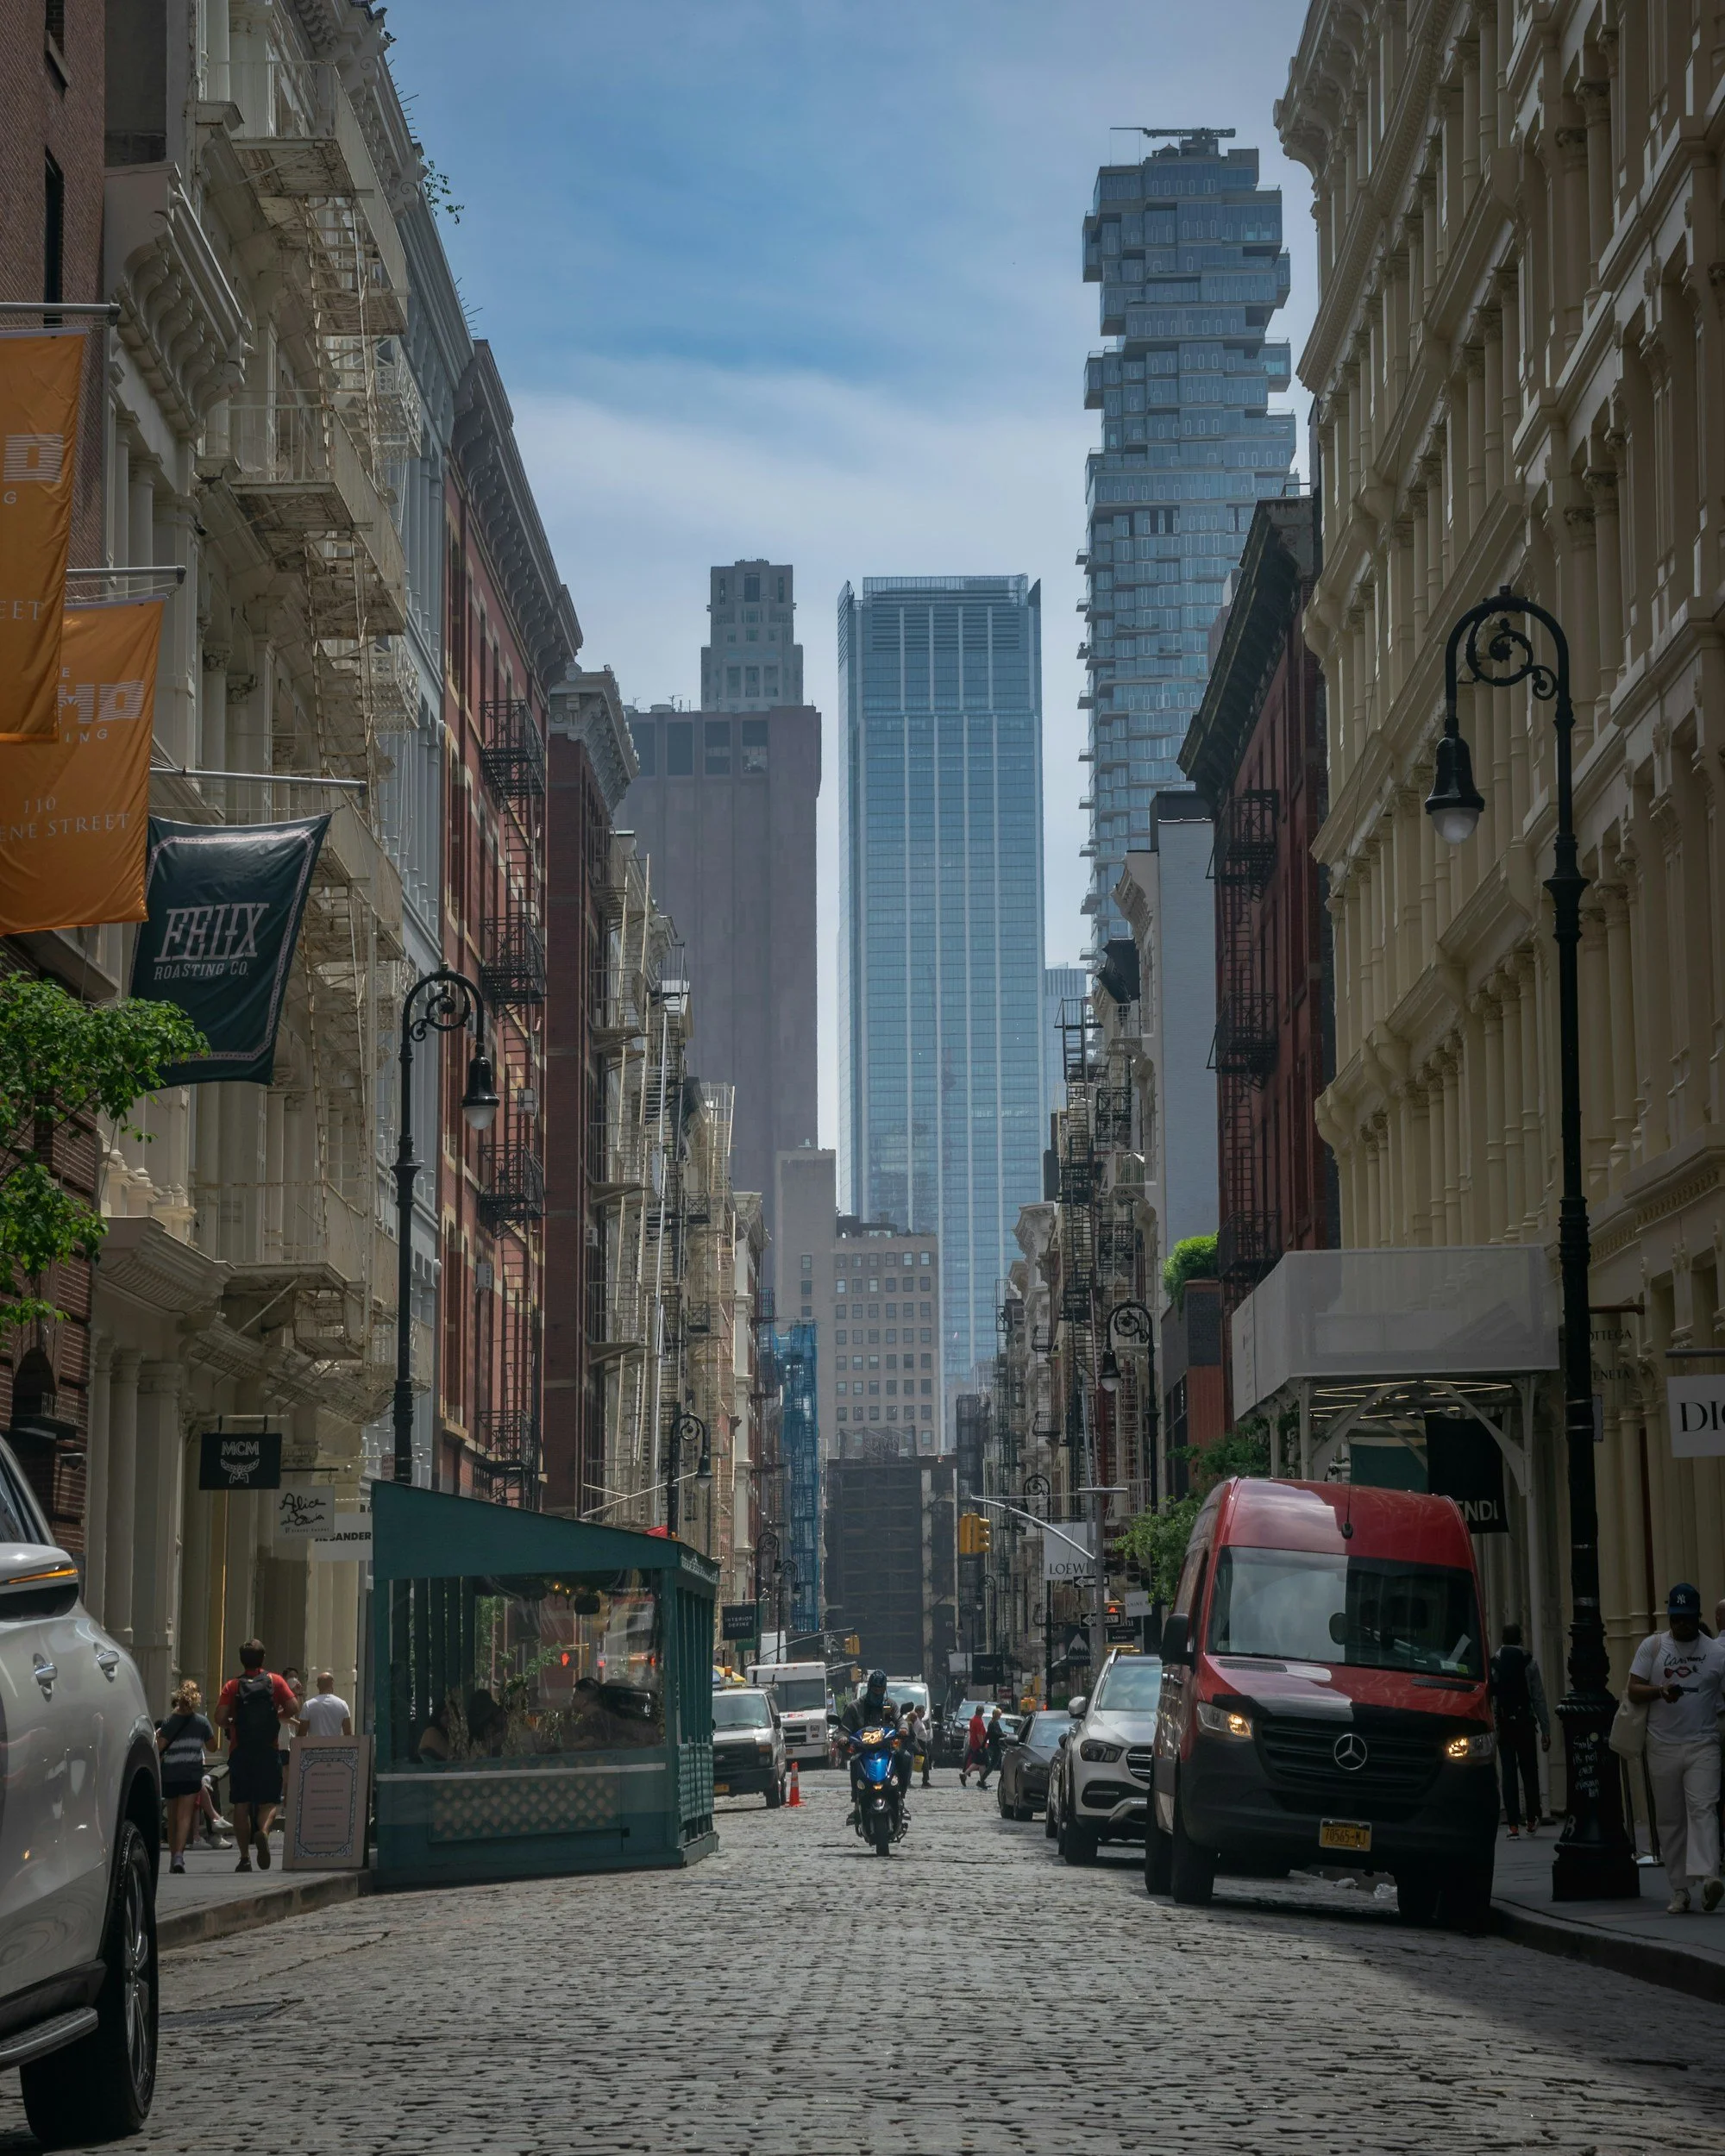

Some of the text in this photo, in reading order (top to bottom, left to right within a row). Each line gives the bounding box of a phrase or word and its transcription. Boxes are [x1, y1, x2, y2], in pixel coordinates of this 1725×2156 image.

[24, 796, 56, 814] 110
[48, 813, 130, 837] STREET
[154, 903, 270, 962] FELIX
[154, 962, 225, 981] ROASTING
[1592, 1369, 1630, 1381] ENETA
[221, 1441, 260, 1456] MCM
